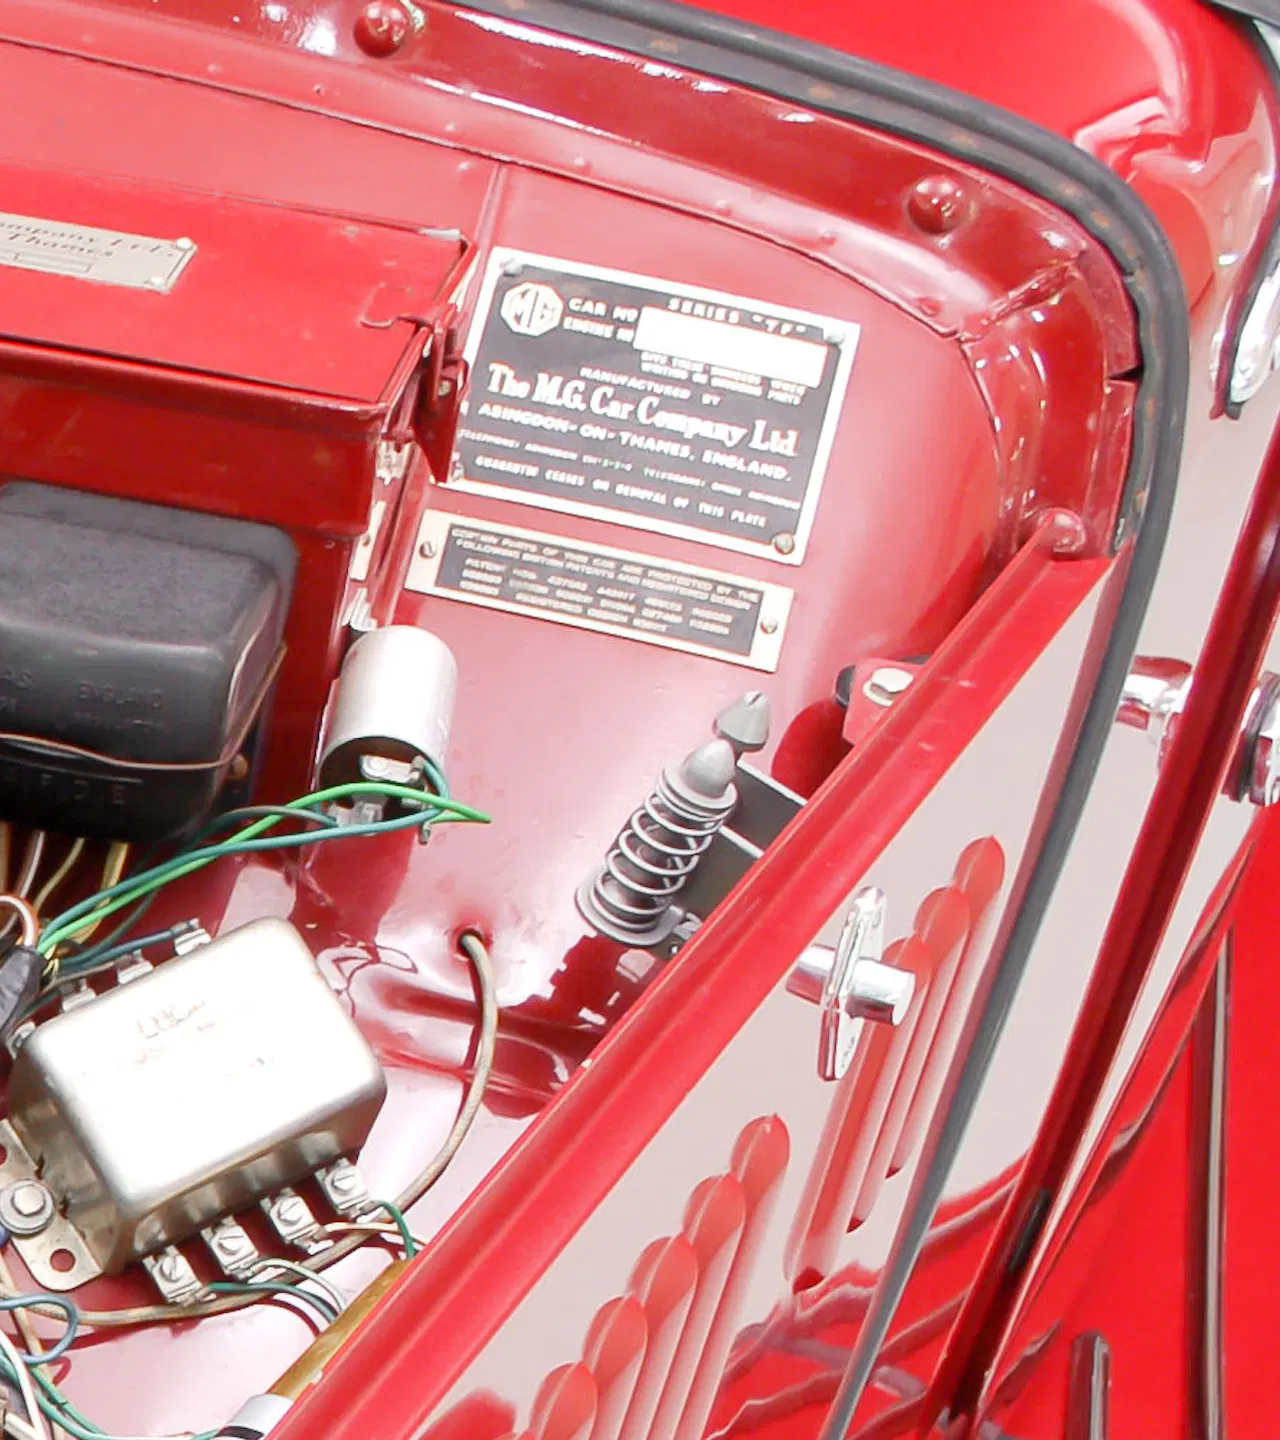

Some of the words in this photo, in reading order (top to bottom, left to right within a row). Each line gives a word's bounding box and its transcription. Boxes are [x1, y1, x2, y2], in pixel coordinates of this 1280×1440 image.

[501, 282, 563, 336] MG
[569, 298, 606, 316] CAR
[668, 298, 740, 323] SERIES
[488, 363, 530, 398] The
[532, 373, 586, 411] M.G.
[590, 386, 634, 419] Car
[638, 396, 747, 447] Company
[580, 367, 691, 399] MANUFACTURED
[702, 394, 720, 405] BY
